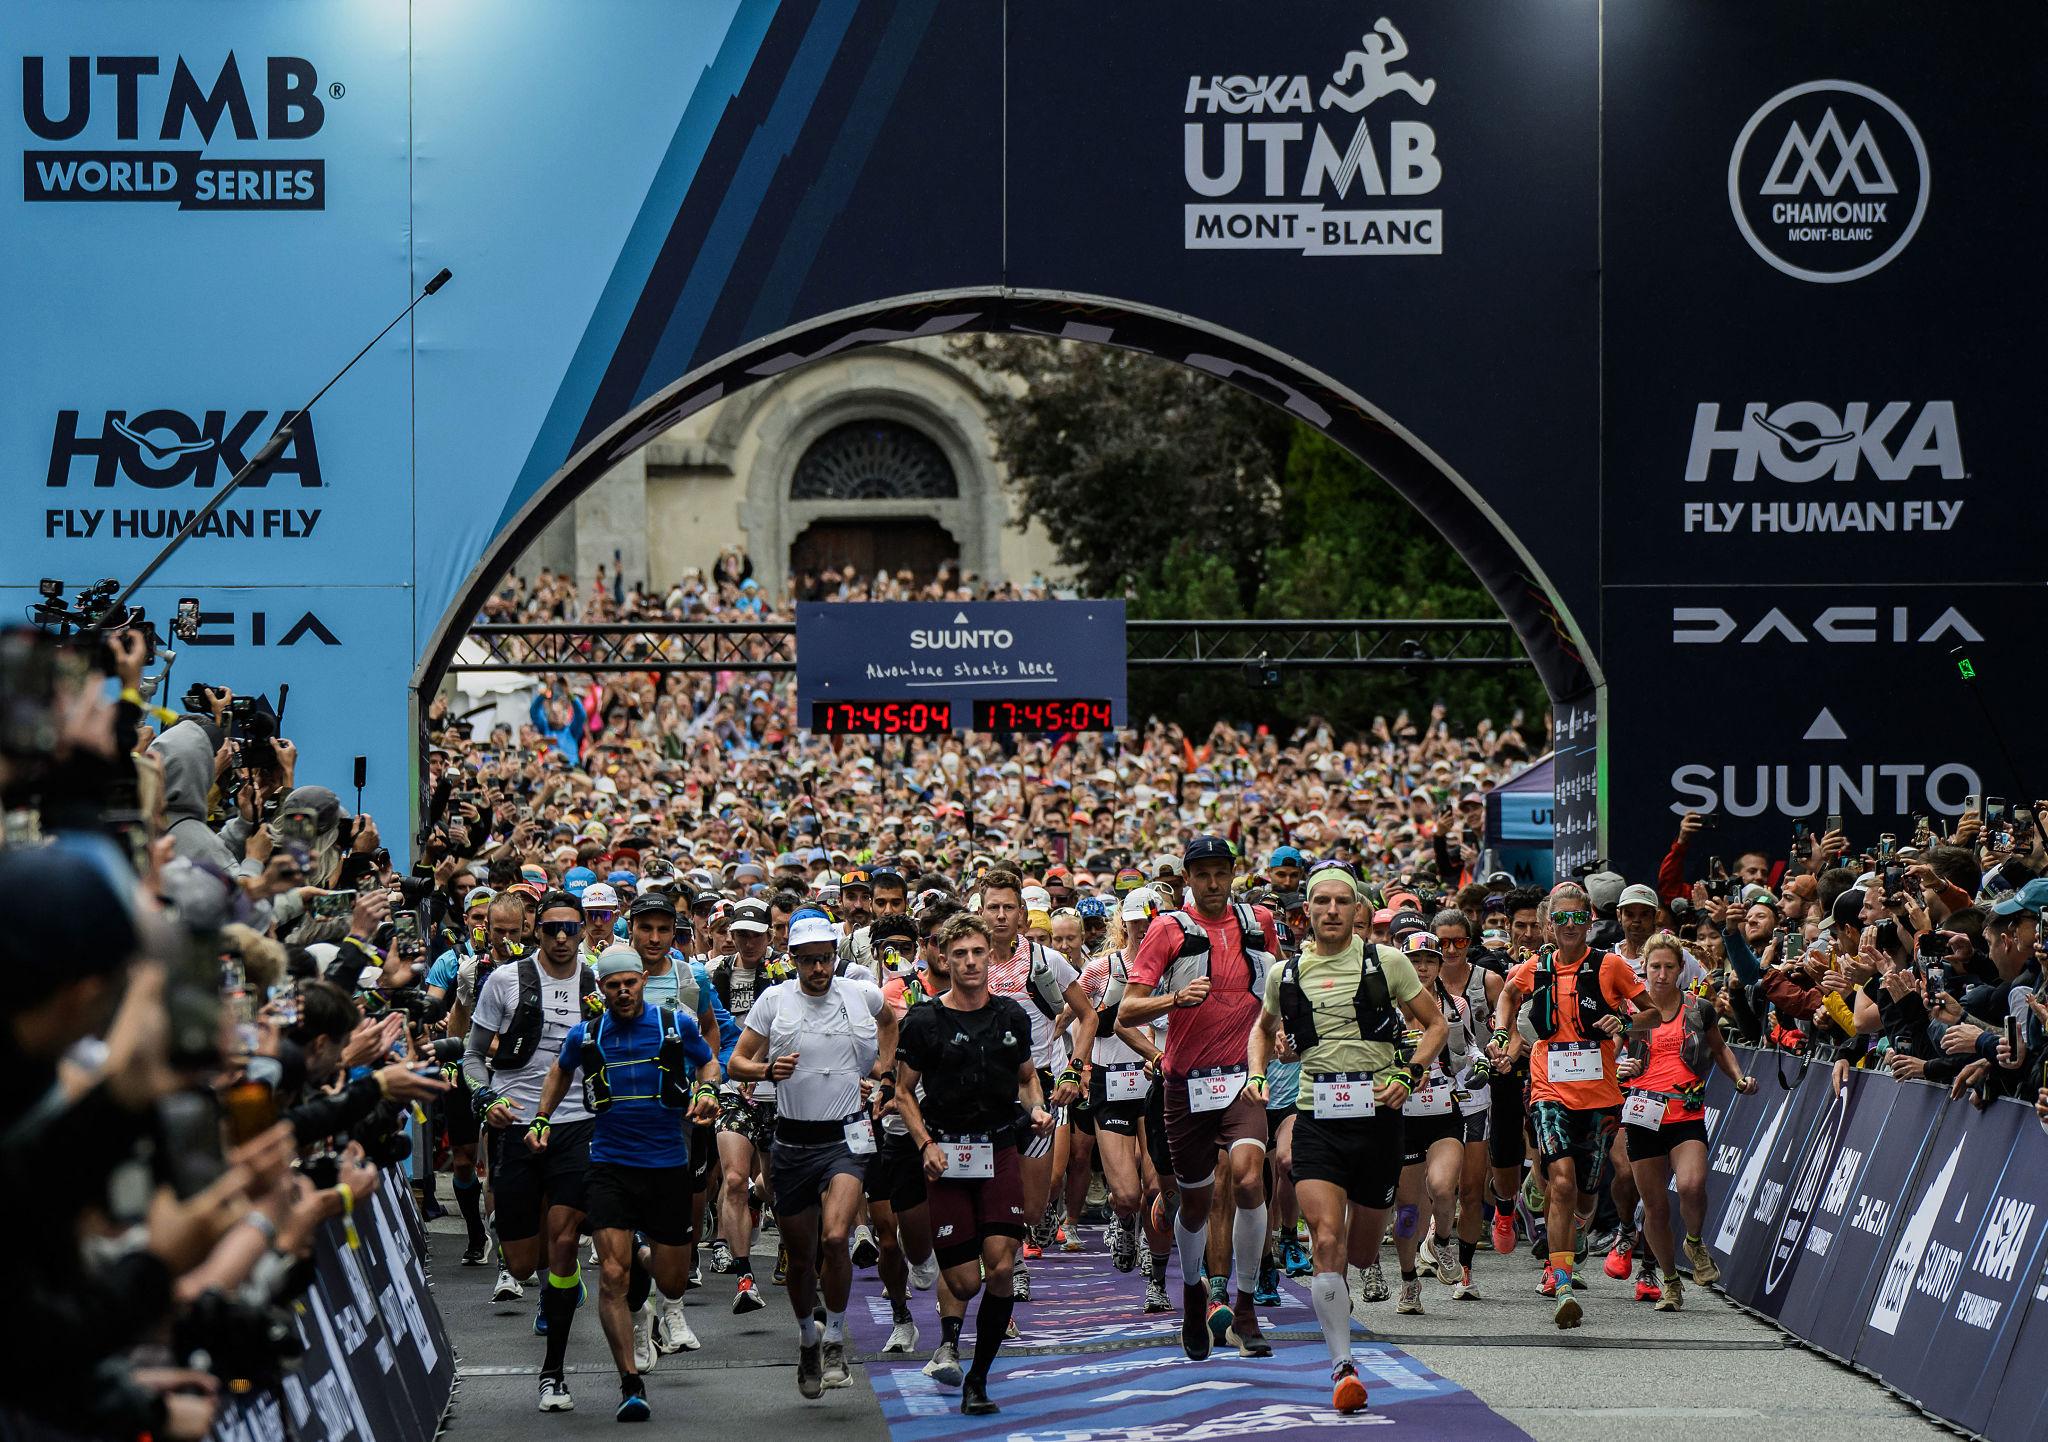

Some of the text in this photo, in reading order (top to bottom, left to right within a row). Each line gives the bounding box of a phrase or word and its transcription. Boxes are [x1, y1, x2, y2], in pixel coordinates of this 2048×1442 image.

[1185, 76, 1313, 114] HOKA
[1185, 117, 1442, 200] UTMB
[36, 161, 315, 201] WORLD SERIES
[1772, 202, 1887, 223] CHAMONIX
[1195, 214, 1432, 246] MONT-BLANC
[1788, 228, 1873, 241] MONT-BLANC
[47, 409, 322, 488] HOKA
[1685, 401, 1965, 482] HOKA
[46, 509, 322, 538] FLY HUMAN FLY
[1685, 500, 1964, 532] FLY HUMAN FLY
[1674, 606, 1985, 643] DACIA
[910, 630, 1013, 649] SUUNTO
[866, 660, 943, 679] Adventure
[827, 704, 949, 733] 17:45:04
[988, 703, 1110, 730] 17:45:04
[1669, 763, 1982, 817] SUUNTO
[1572, 1058, 1577, 1067] 1
[1129, 1078, 1136, 1087] 5
[1212, 1084, 1226, 1095] 50
[1335, 1091, 1351, 1102] 36
[1420, 1094, 1434, 1103] 33
[1632, 1104, 1645, 1113] 62
[958, 1152, 972, 1163] 39
[1851, 1194, 1891, 1237] DACIA
[1972, 1195, 2036, 1283] HOKA
[1916, 1239, 1963, 1304] SUUNTO
